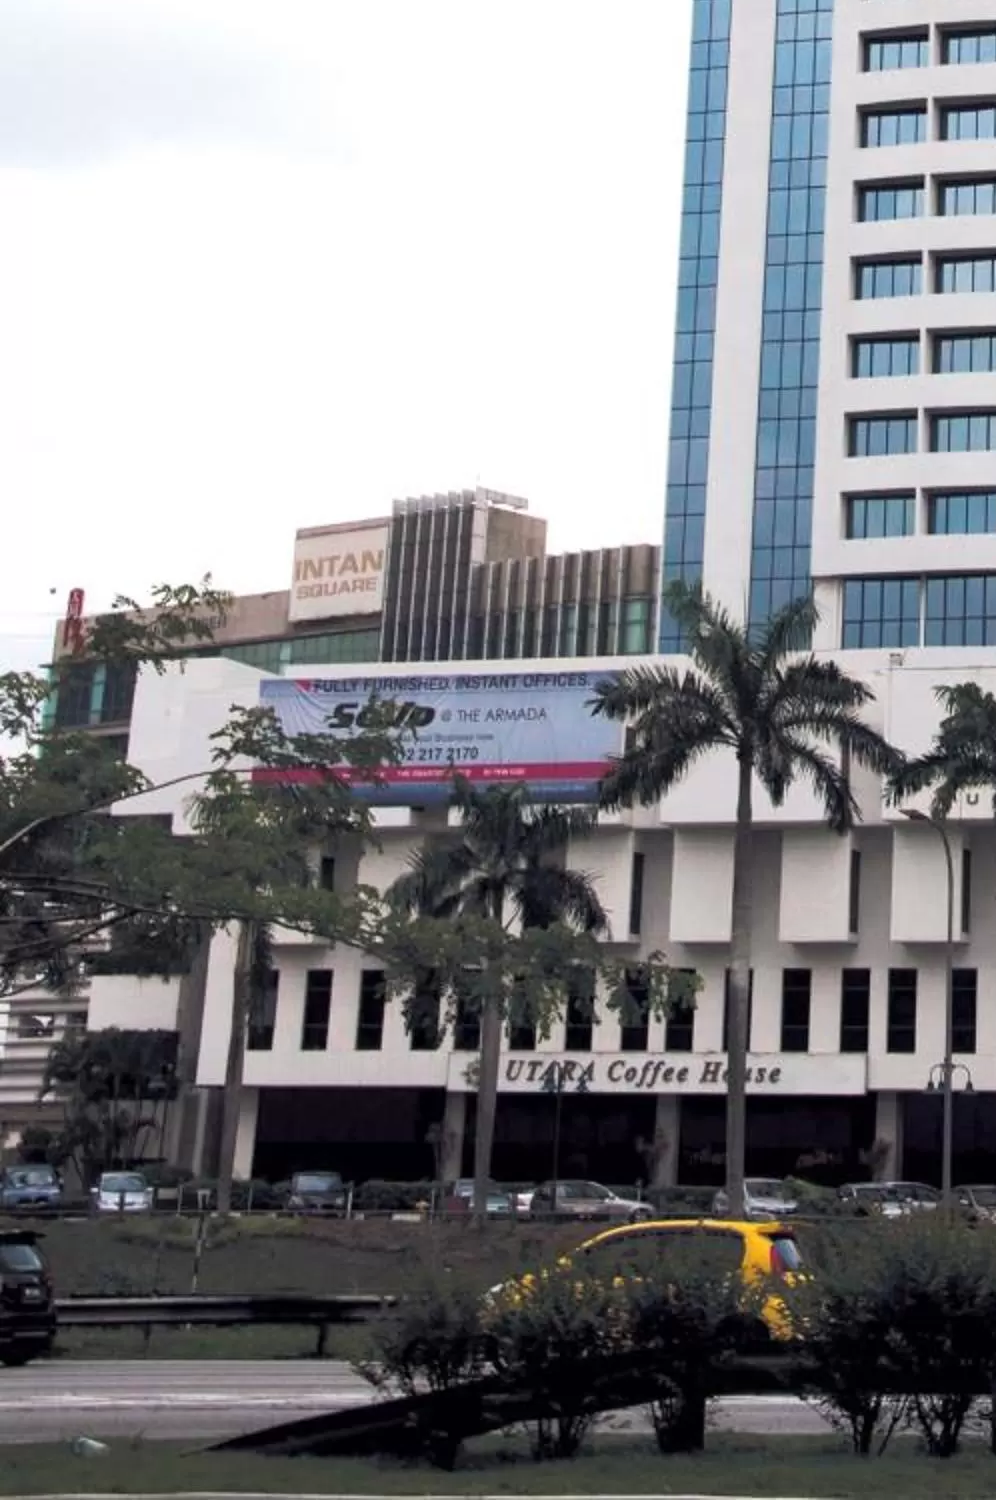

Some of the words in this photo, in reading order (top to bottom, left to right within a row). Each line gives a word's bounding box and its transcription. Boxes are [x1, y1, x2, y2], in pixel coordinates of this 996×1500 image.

[296, 549, 384, 581] INTAN
[296, 577, 378, 600] SQUARE
[455, 673, 519, 690] INSTANT
[457, 707, 481, 722] THE
[484, 706, 548, 722] ARMADA
[419, 747, 443, 760] 217
[506, 1059, 595, 1082] UTARA
[607, 1059, 689, 1088] Coffee
